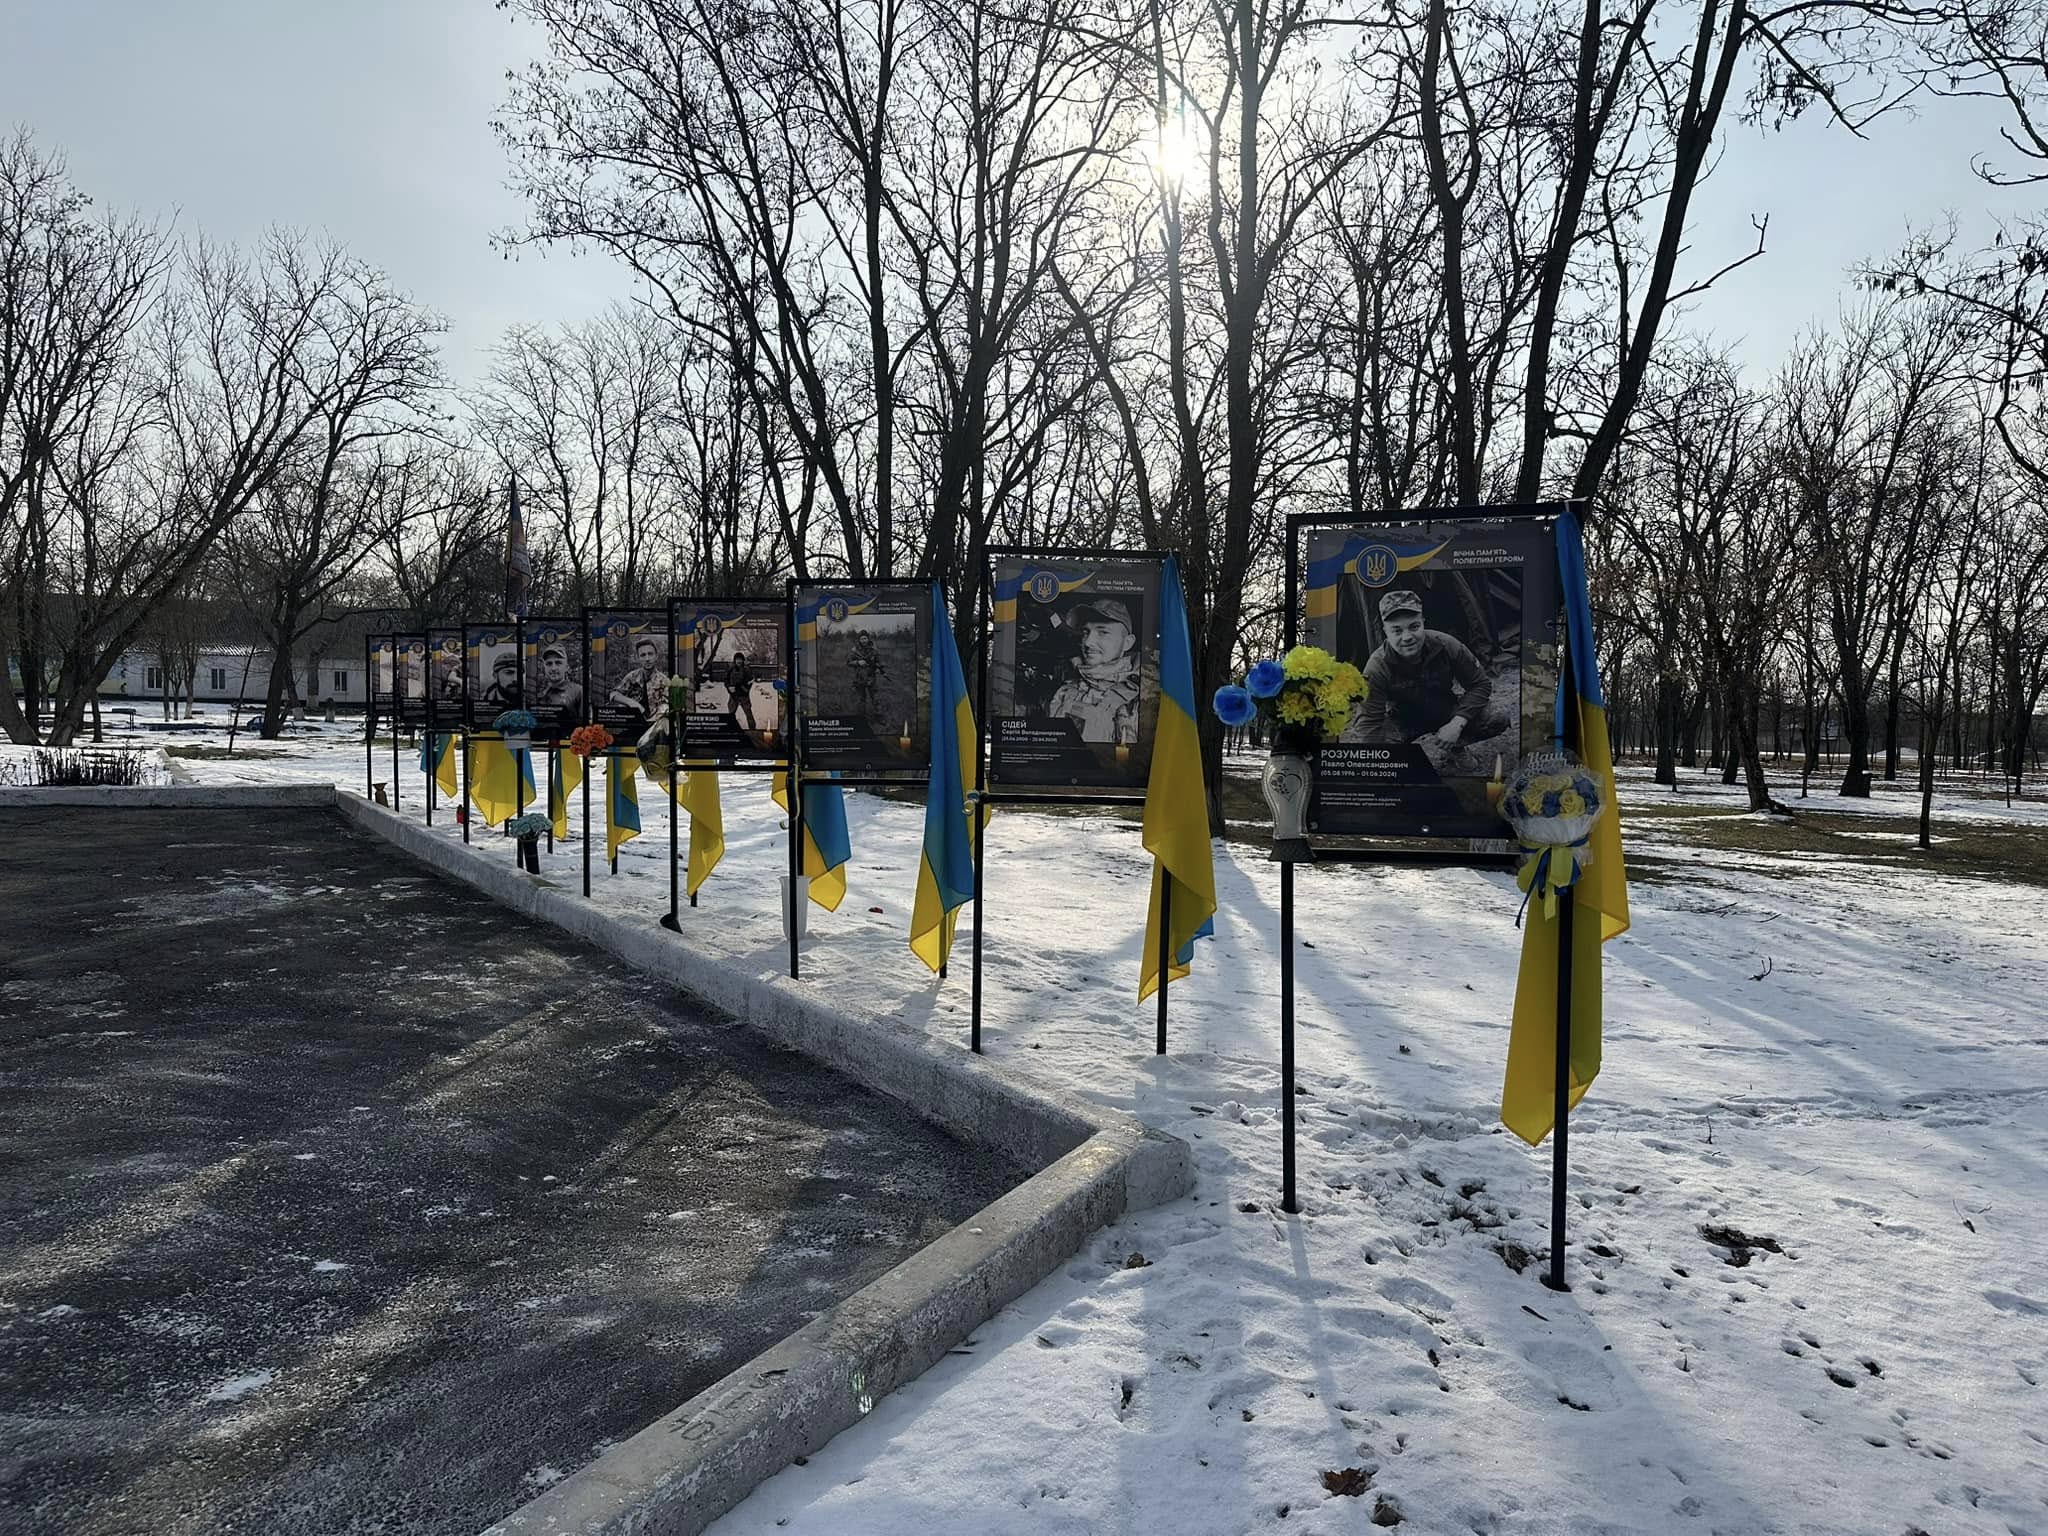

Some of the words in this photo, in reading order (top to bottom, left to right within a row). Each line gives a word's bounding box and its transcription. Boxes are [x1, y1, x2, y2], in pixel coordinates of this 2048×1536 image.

[1453, 557, 1494, 565] ПОЛЕГЛИМ
[1002, 720, 1027, 728] СІДЕЙ
[1321, 750, 1390, 759] РОЗУМЕНКО
[1321, 760, 1345, 768] Павло
[1346, 761, 1408, 769] Олександрович
